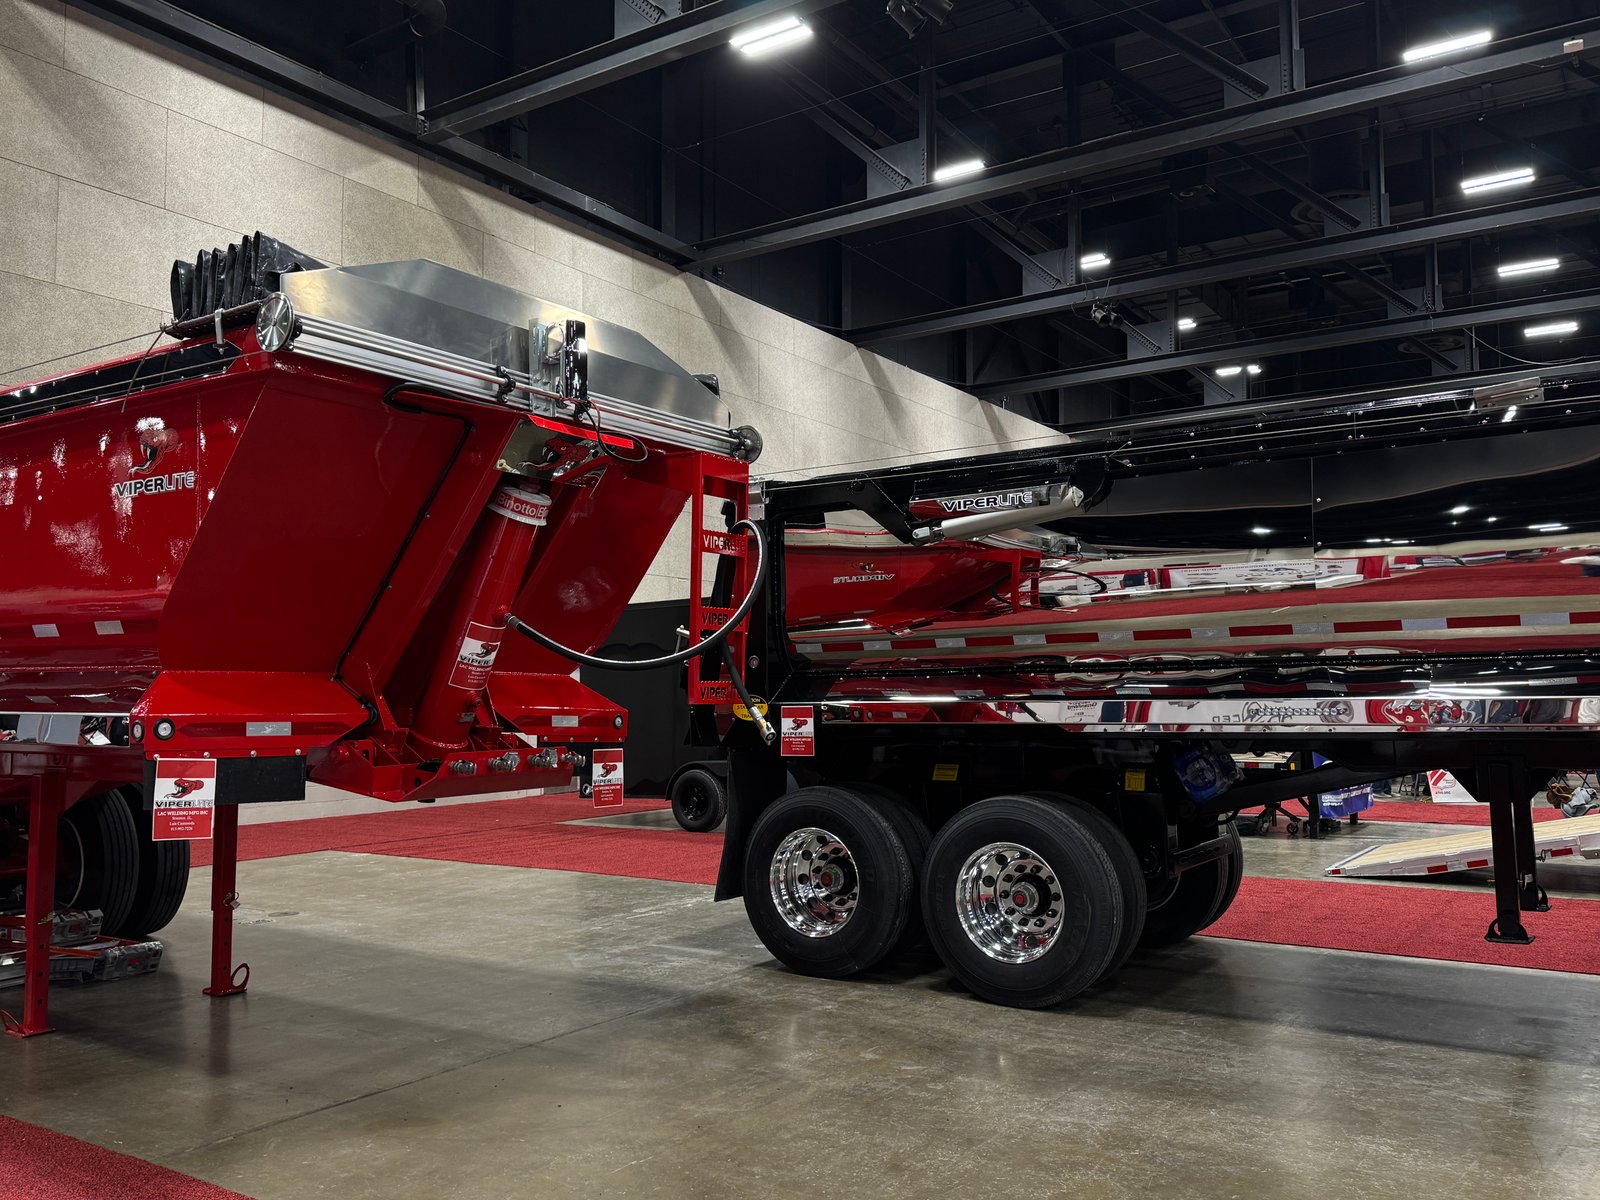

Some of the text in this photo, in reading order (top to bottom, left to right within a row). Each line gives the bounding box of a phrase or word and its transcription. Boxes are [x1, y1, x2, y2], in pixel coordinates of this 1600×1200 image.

[115, 471, 195, 498] VIPERLITE
[497, 494, 537, 516] Binotto
[942, 491, 1033, 513] VIPERLITE
[155, 800, 213, 808] VIPERLITE
